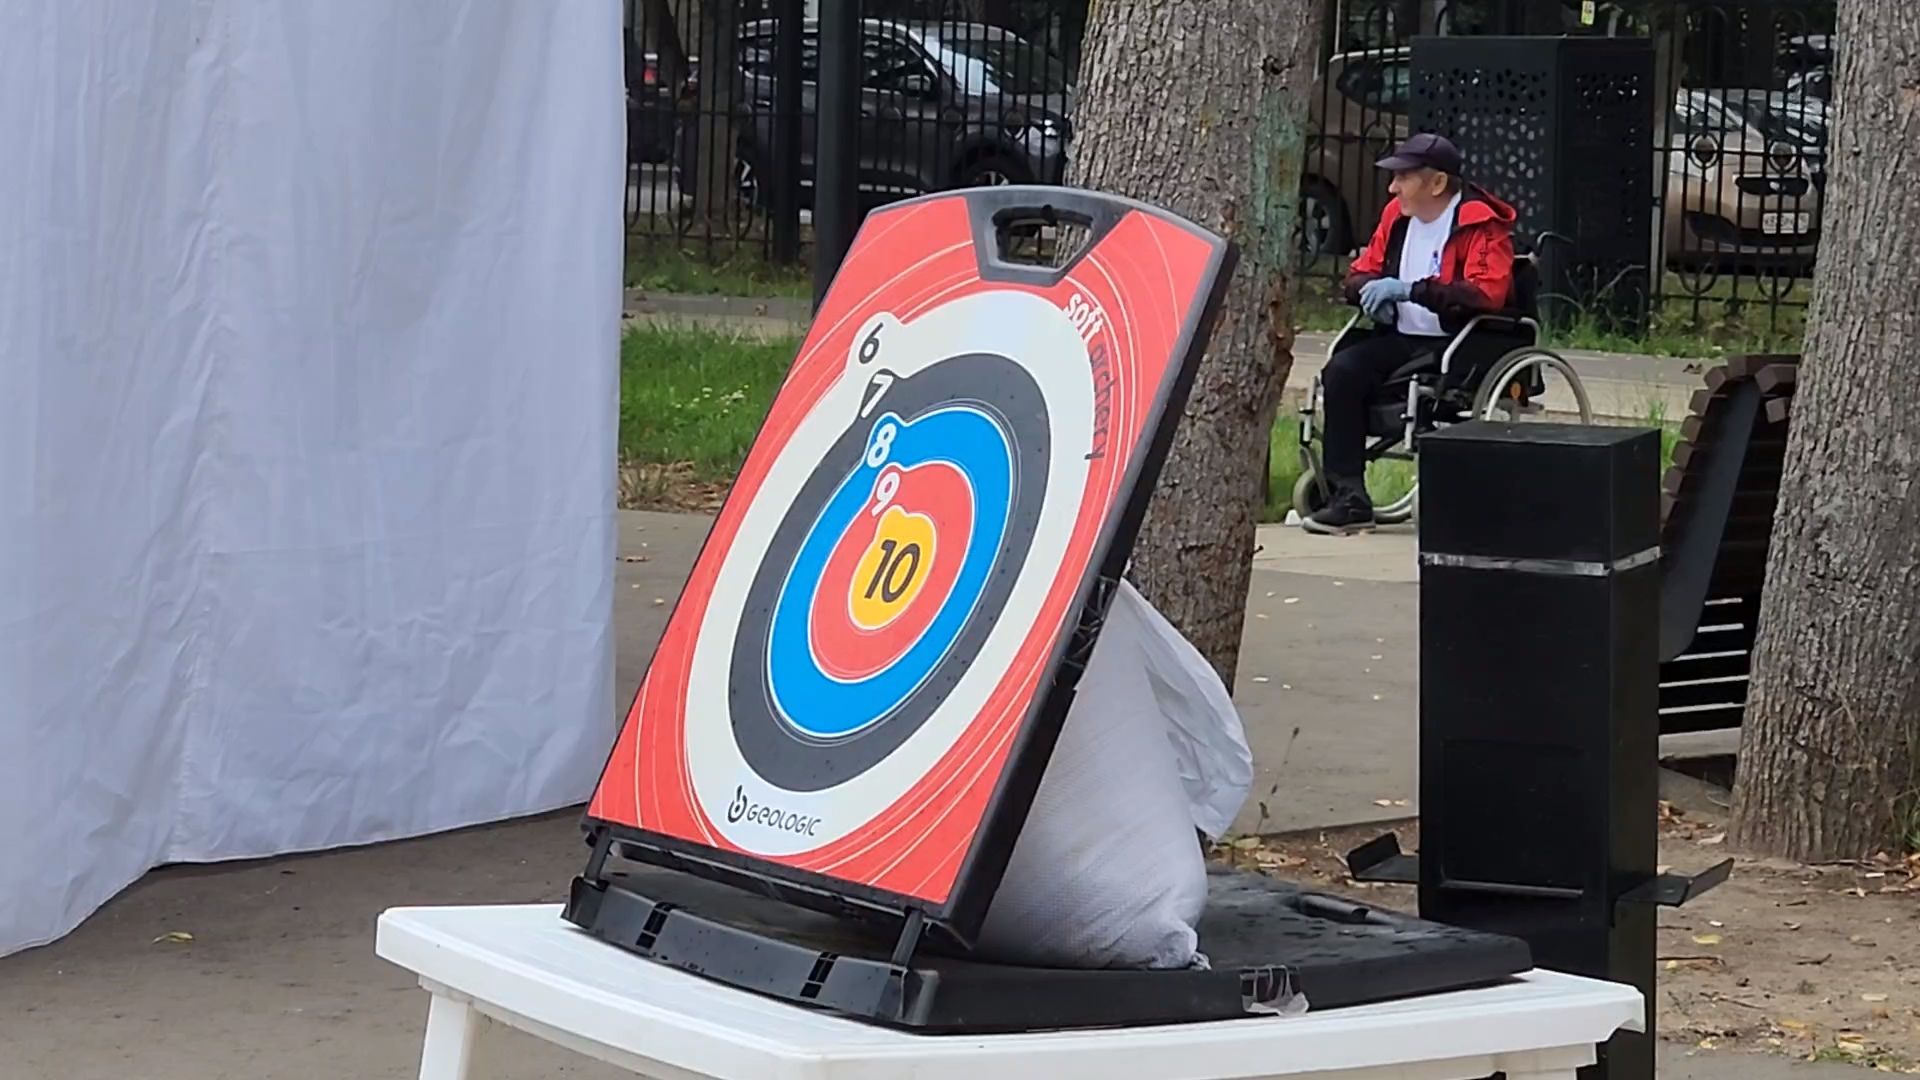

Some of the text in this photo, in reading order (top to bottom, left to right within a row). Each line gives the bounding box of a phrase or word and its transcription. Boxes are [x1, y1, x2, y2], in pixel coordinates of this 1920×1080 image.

[1063, 293, 1104, 344] soft
[858, 322, 884, 365] 6
[861, 372, 894, 419] 7
[867, 423, 897, 468] 8
[871, 471, 901, 518] 9
[863, 539, 921, 604] 10
